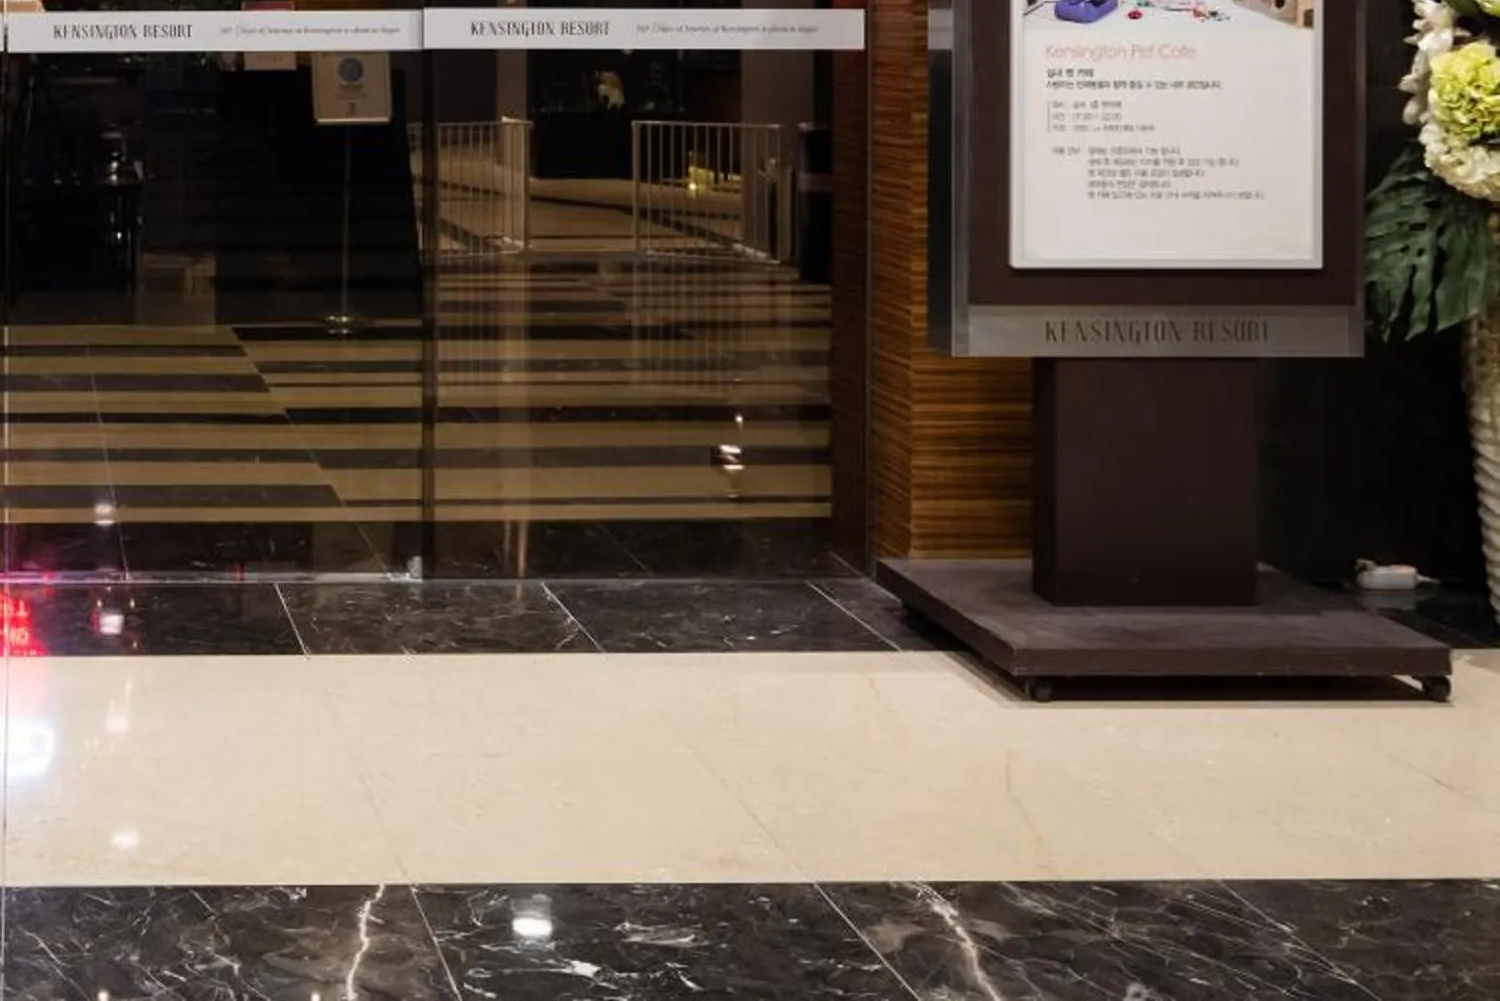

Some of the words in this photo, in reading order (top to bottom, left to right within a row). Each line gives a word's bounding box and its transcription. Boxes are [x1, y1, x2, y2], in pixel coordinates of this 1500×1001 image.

[53, 24, 137, 41] KENSINGTON
[143, 24, 193, 39] RESORT
[470, 21, 555, 38] KENSINGTON
[560, 21, 611, 37] RESORT
[1044, 318, 1182, 345] KENSINGTON
[1192, 318, 1270, 344] RESORT
